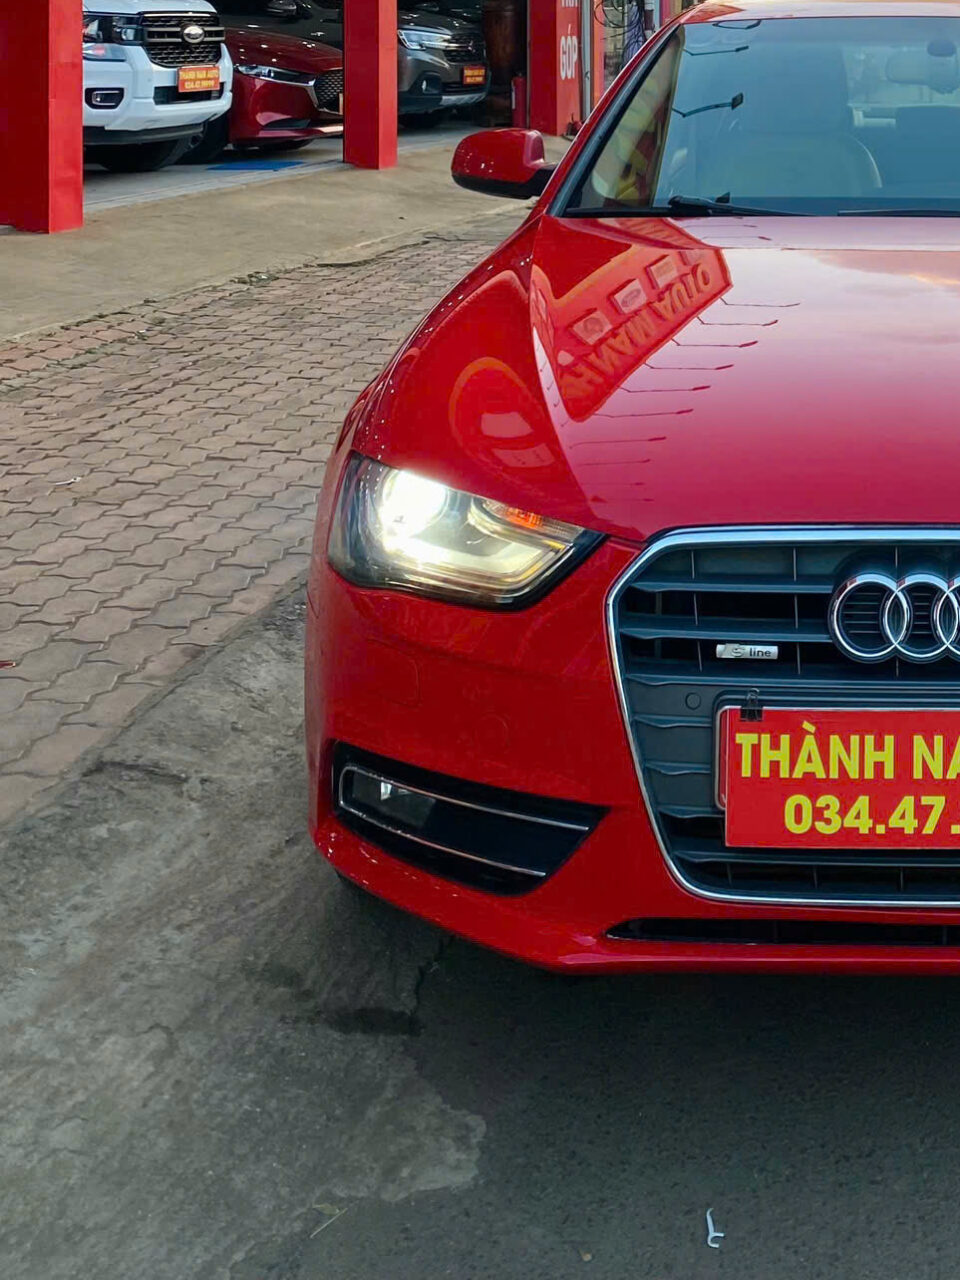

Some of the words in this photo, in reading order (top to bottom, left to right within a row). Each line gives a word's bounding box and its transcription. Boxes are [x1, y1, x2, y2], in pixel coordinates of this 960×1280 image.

[560, 24, 578, 80] GÓP
[749, 647, 772, 657] line
[735, 720, 894, 780] THÀNH
